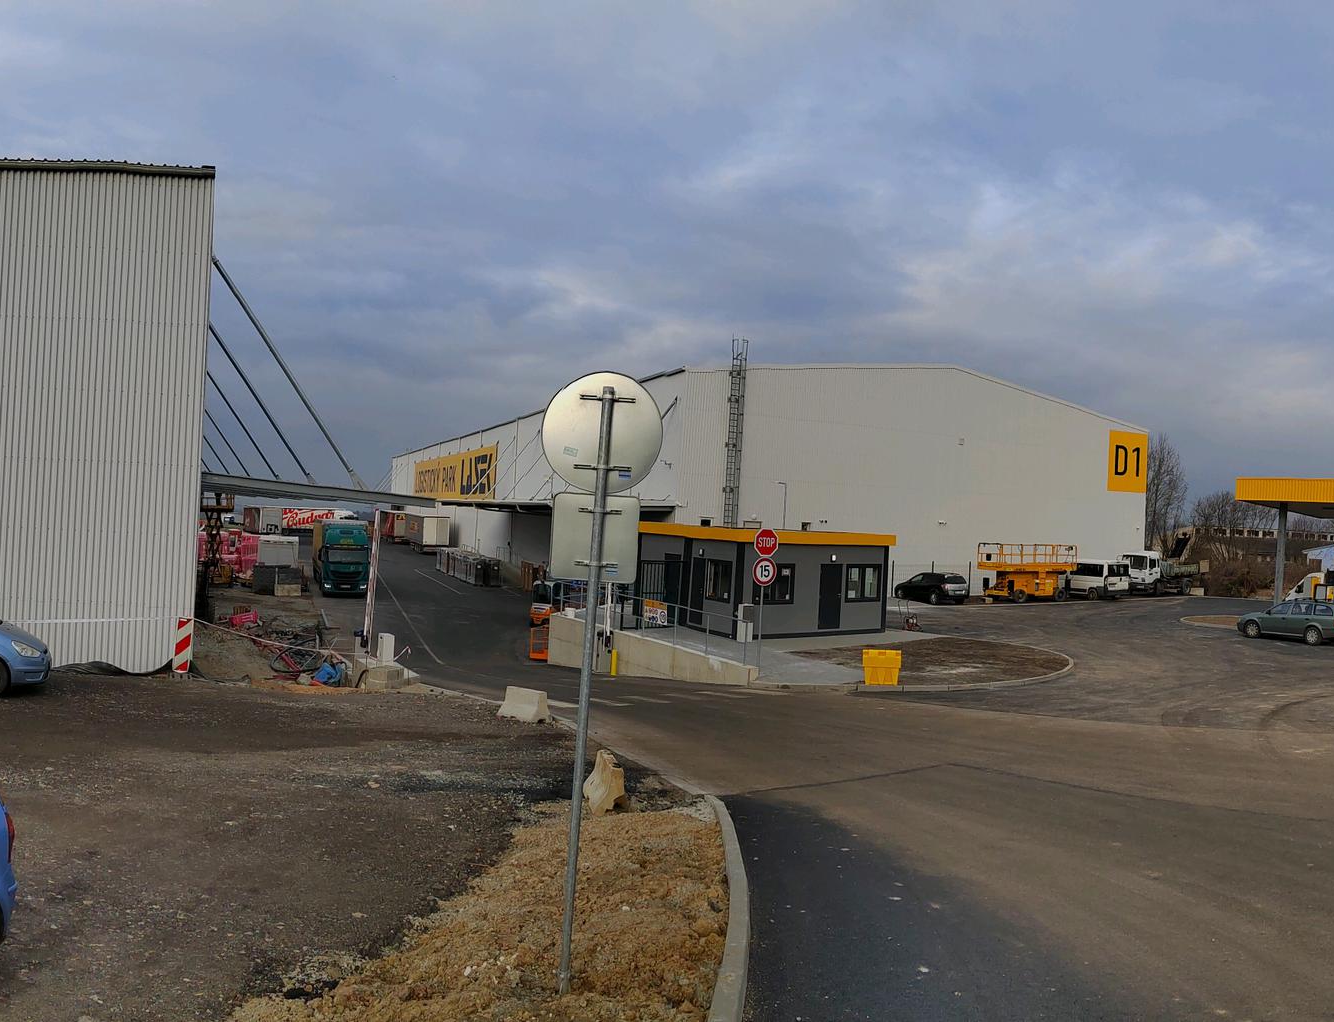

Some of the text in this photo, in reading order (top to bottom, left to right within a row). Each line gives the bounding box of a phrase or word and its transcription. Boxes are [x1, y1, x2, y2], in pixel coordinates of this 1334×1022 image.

[1114, 445, 1140, 477] D1
[442, 465, 457, 493] PARK
[758, 537, 775, 547] STOP
[760, 565, 771, 578] 15
